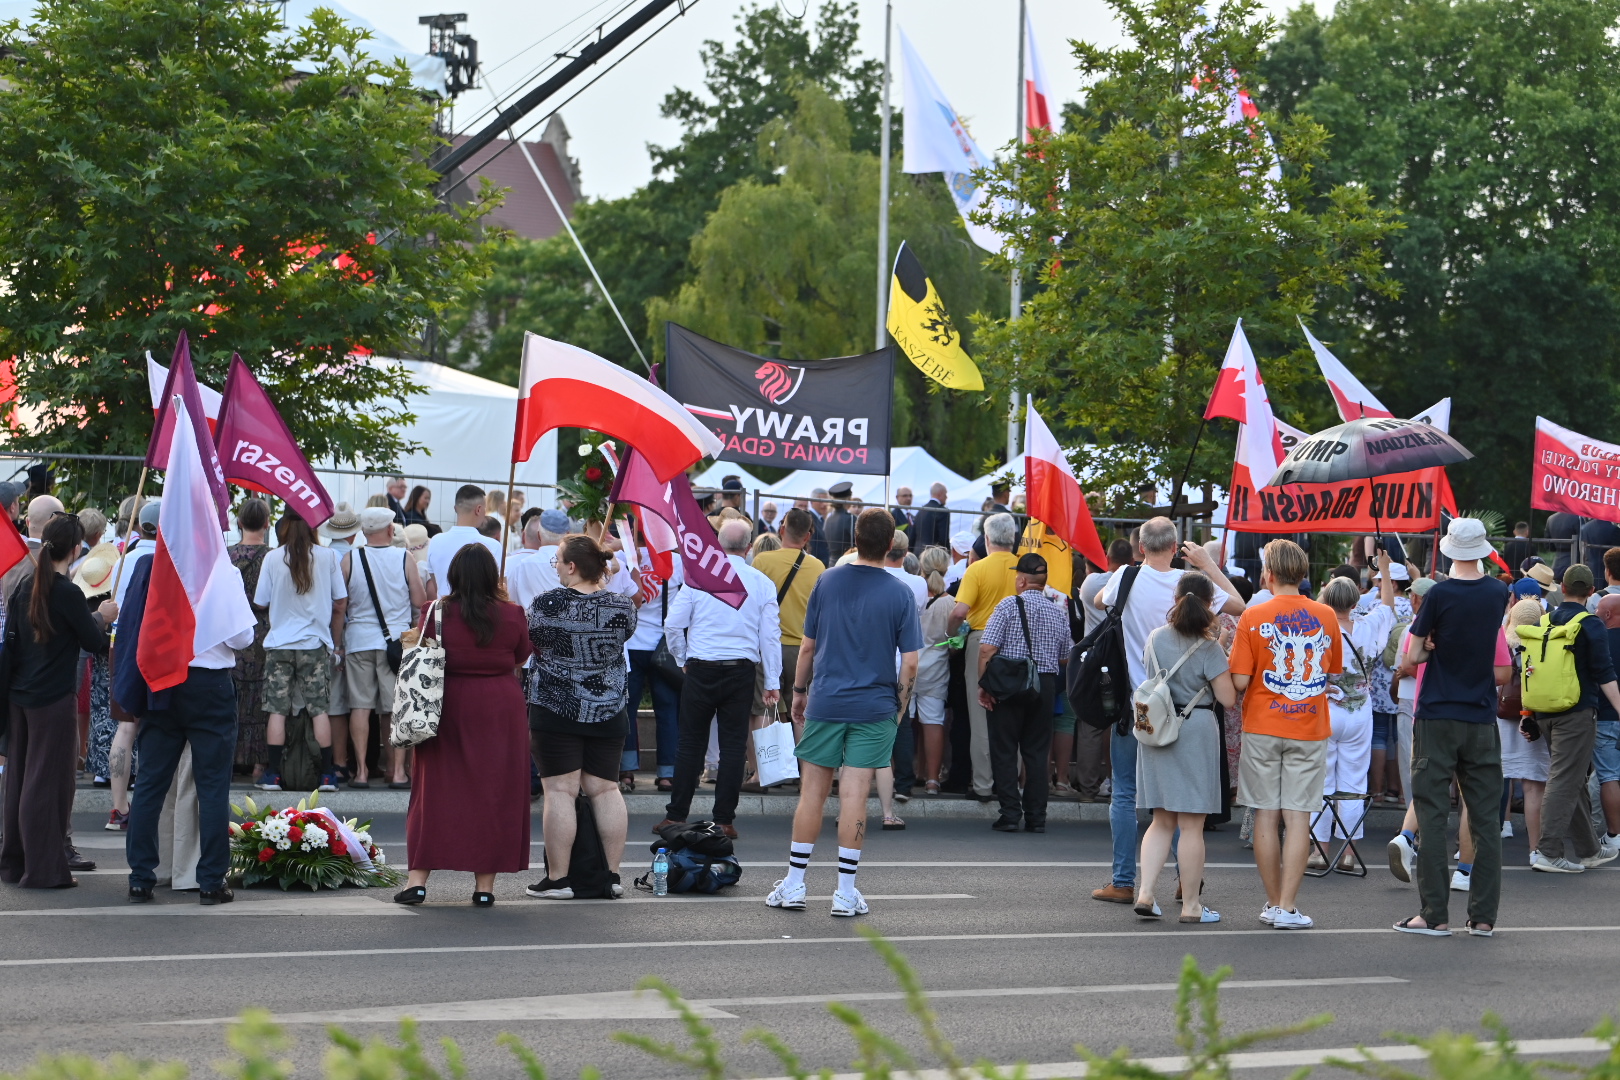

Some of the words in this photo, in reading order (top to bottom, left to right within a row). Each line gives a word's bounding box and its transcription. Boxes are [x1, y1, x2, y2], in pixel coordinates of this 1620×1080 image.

[893, 325, 954, 385] KASZËBË
[1293, 440, 1349, 463] UMP
[1366, 431, 1447, 456] NADZIEJA
[232, 439, 321, 509] razem
[1274, 607, 1310, 624] BRAIN
[1280, 616, 1321, 634] WASH
[1279, 703, 1310, 714] ALERT
